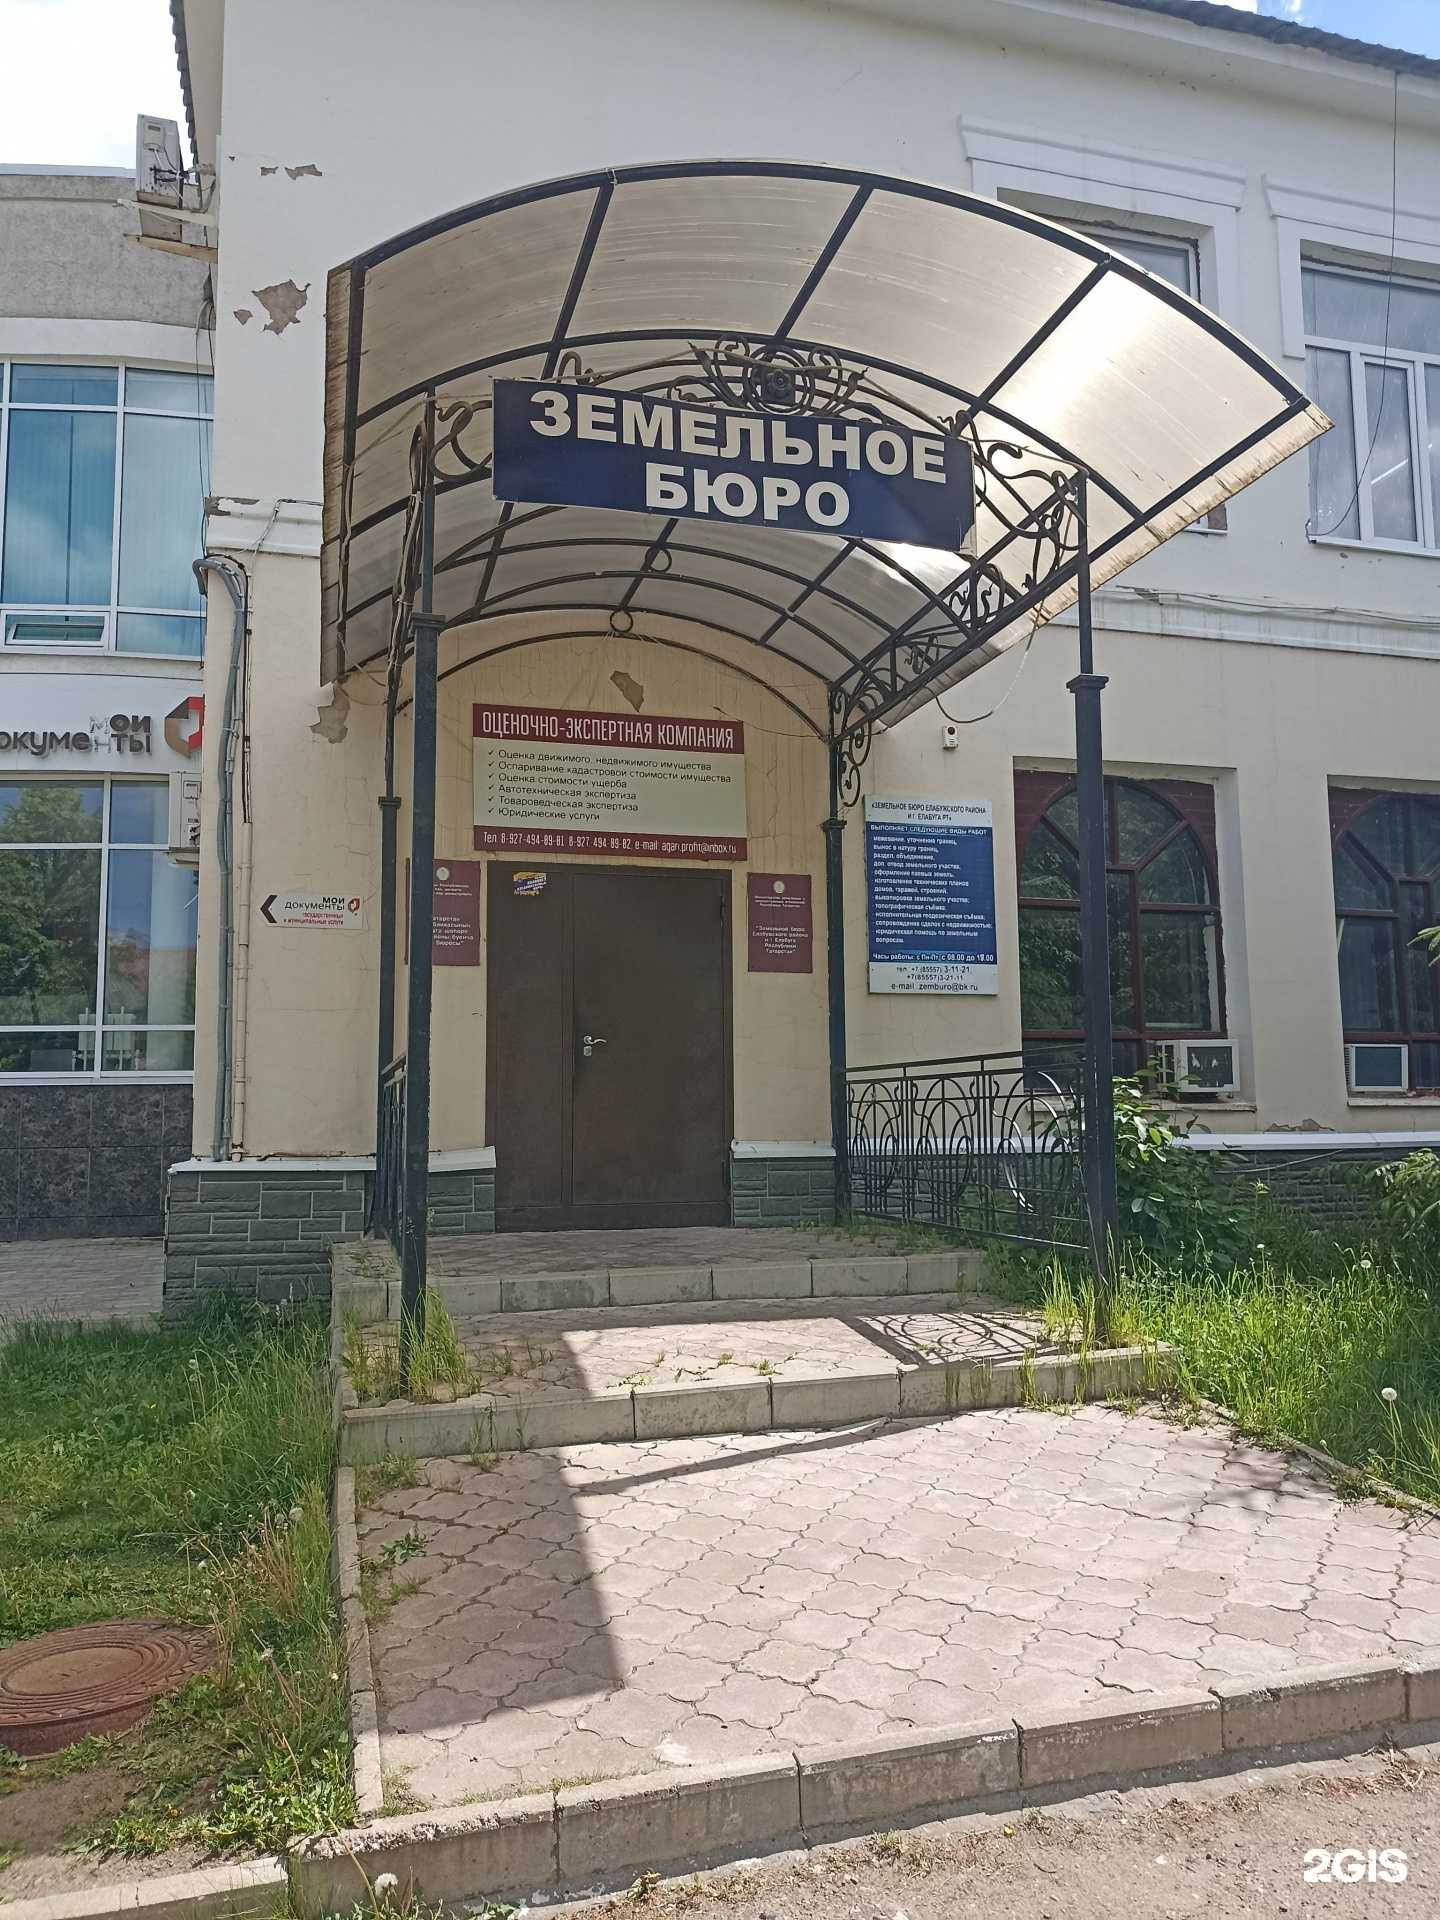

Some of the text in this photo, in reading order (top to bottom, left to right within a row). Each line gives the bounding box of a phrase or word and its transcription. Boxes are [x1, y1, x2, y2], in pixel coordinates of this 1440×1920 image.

[530, 390, 947, 484] ЗЕМЕЛЬНОЕ
[646, 462, 850, 527] БЮРО
[482, 711, 734, 749] ОЦЕНОЧНО-ЭКСПЕРТНАЯ КОМПАНИЯ
[499, 749, 535, 760] Оценка
[596, 757, 658, 768] недвижимого
[661, 761, 711, 771] имущества
[499, 761, 731, 783] Оспаривание кадастровой стоимости имущества
[499, 772, 627, 789] Оценка стоимости ущерба
[499, 784, 636, 800] Автотехническая экспертиза
[499, 796, 639, 811] Товароведческая экспертиза
[908, 803, 924, 811] БЮРО
[925, 804, 964, 813] ЕЛАБУЖСКОГО
[499, 807, 600, 822] Юридические услуги
[284, 901, 345, 911] документы
